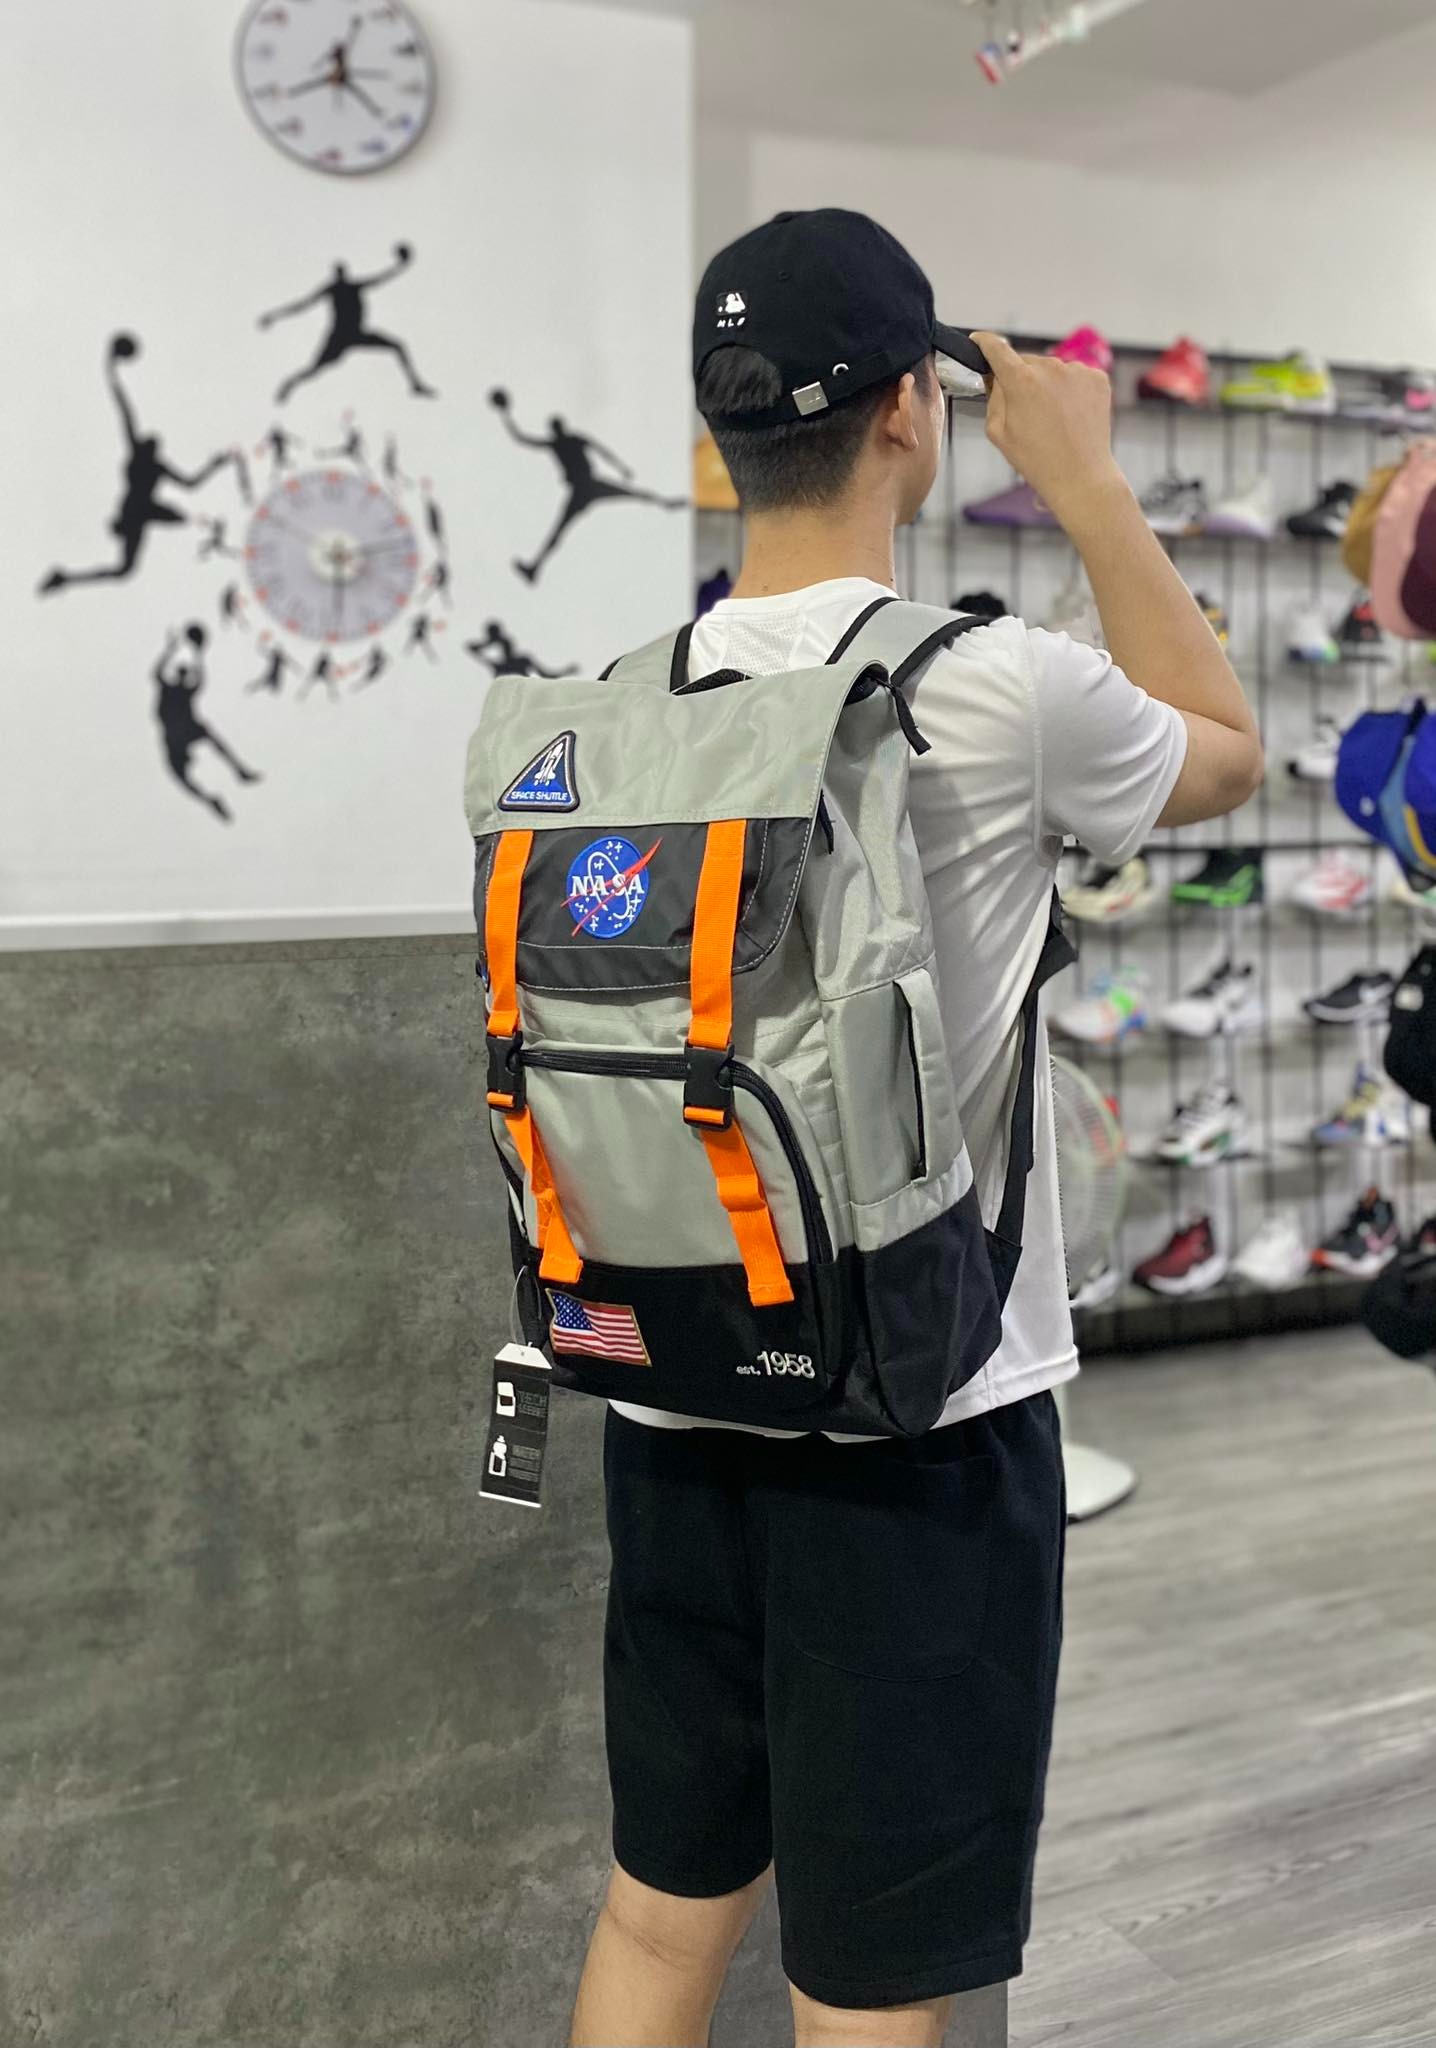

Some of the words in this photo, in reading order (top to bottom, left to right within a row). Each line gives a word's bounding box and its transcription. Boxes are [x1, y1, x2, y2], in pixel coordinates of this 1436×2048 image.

[511, 790, 535, 800] SPACE
[536, 791, 568, 801] SHUTTLE
[570, 873, 645, 897] NASA
[757, 1350, 816, 1379] 1958
